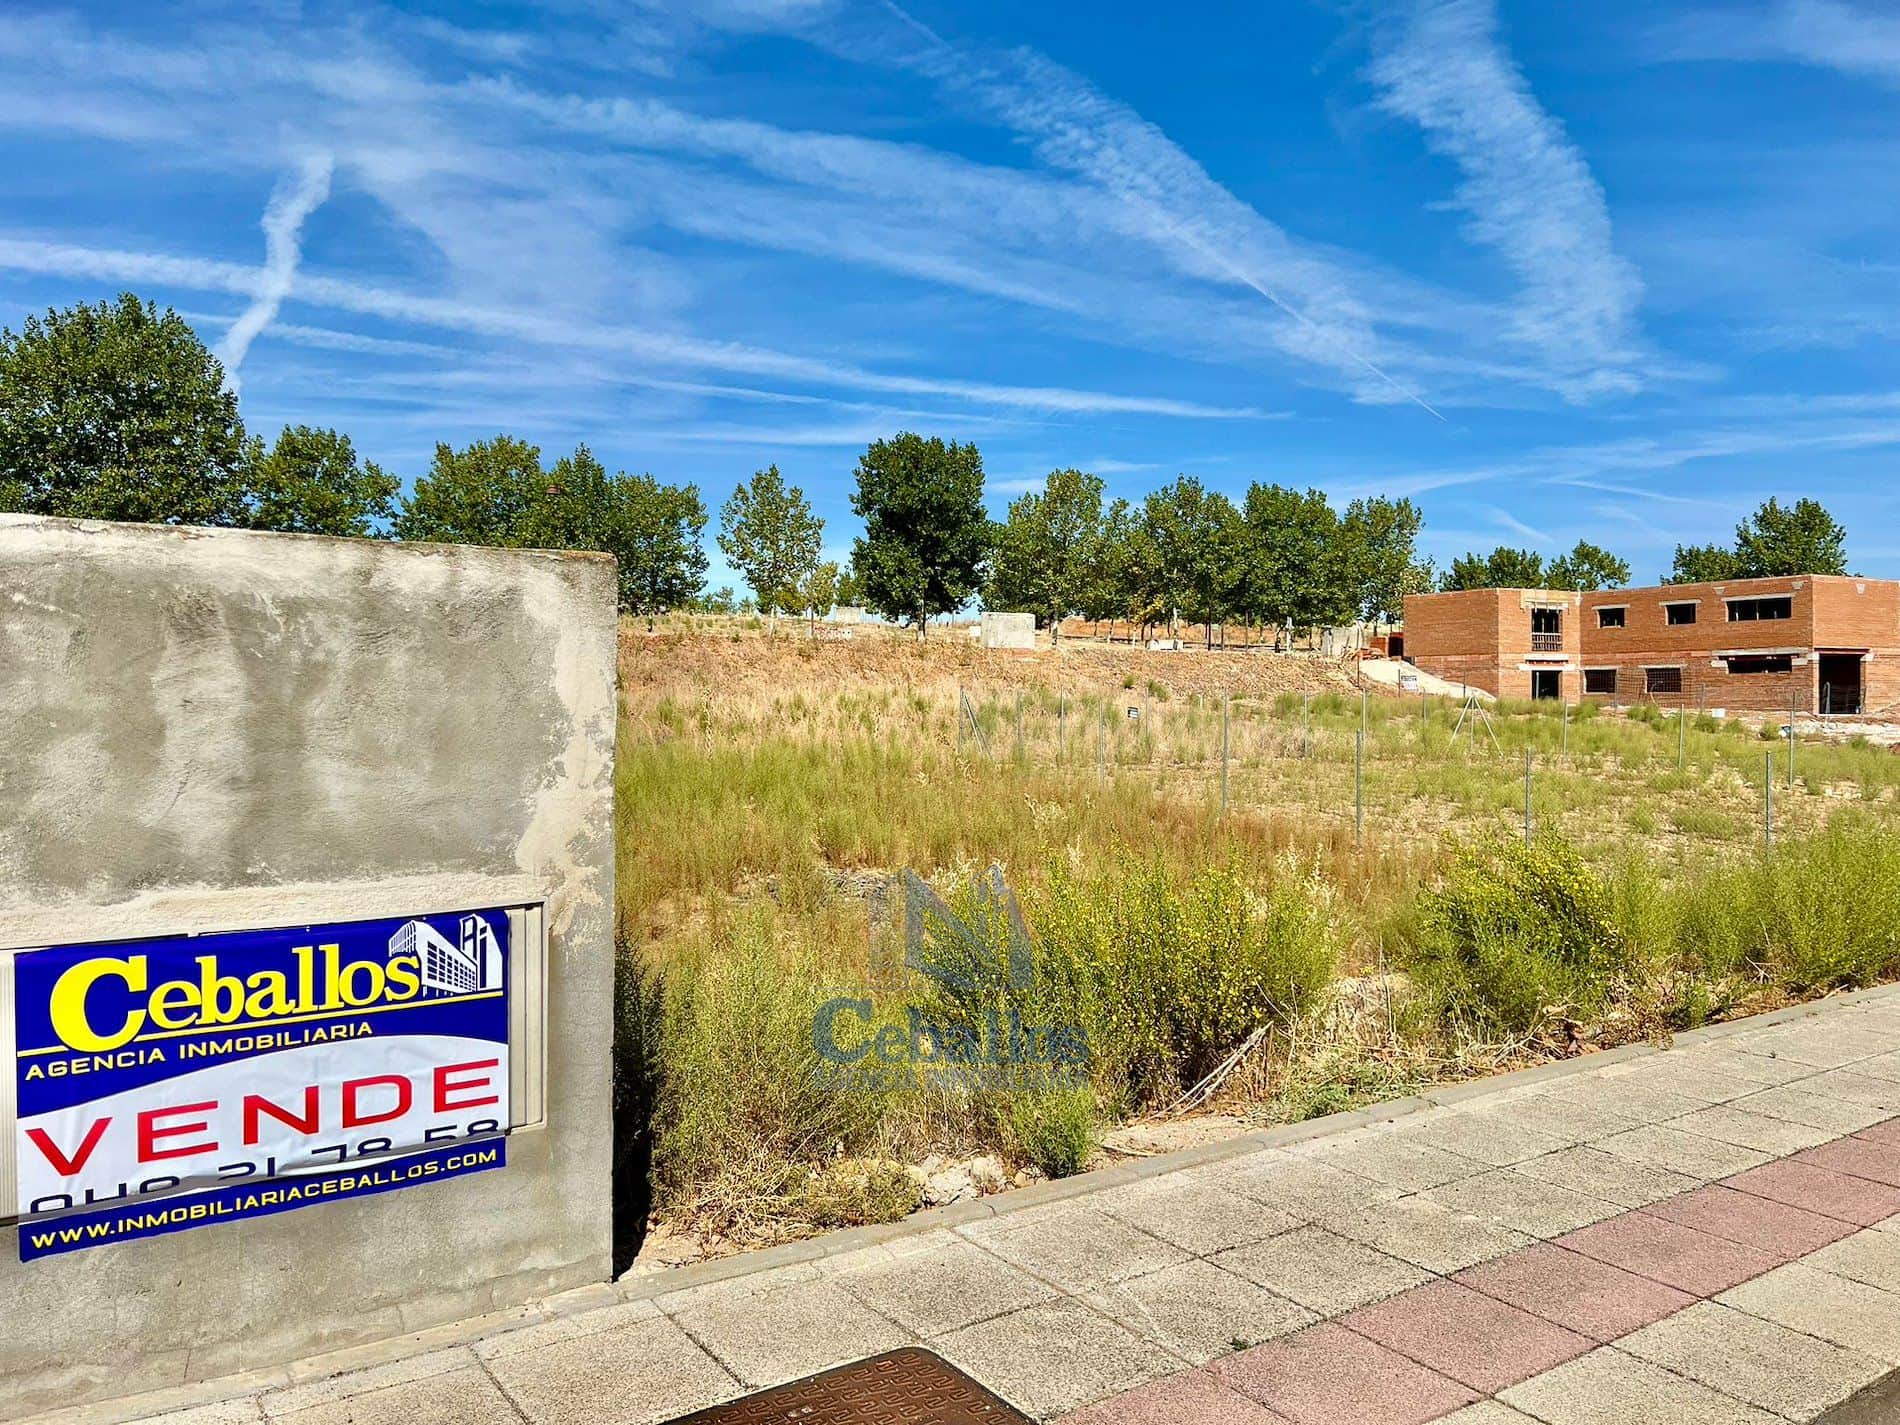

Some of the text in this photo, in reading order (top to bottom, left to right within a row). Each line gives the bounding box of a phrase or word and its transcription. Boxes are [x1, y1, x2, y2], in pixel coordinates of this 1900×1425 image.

[49, 943, 420, 1053] Ceballos
[25, 1022, 373, 1080] AGENCIA INMOBILIARIA
[25, 1058, 499, 1177] VENDE
[31, 1148, 498, 1248] WWW.INMOBILIARIACEBALLOS.COM
